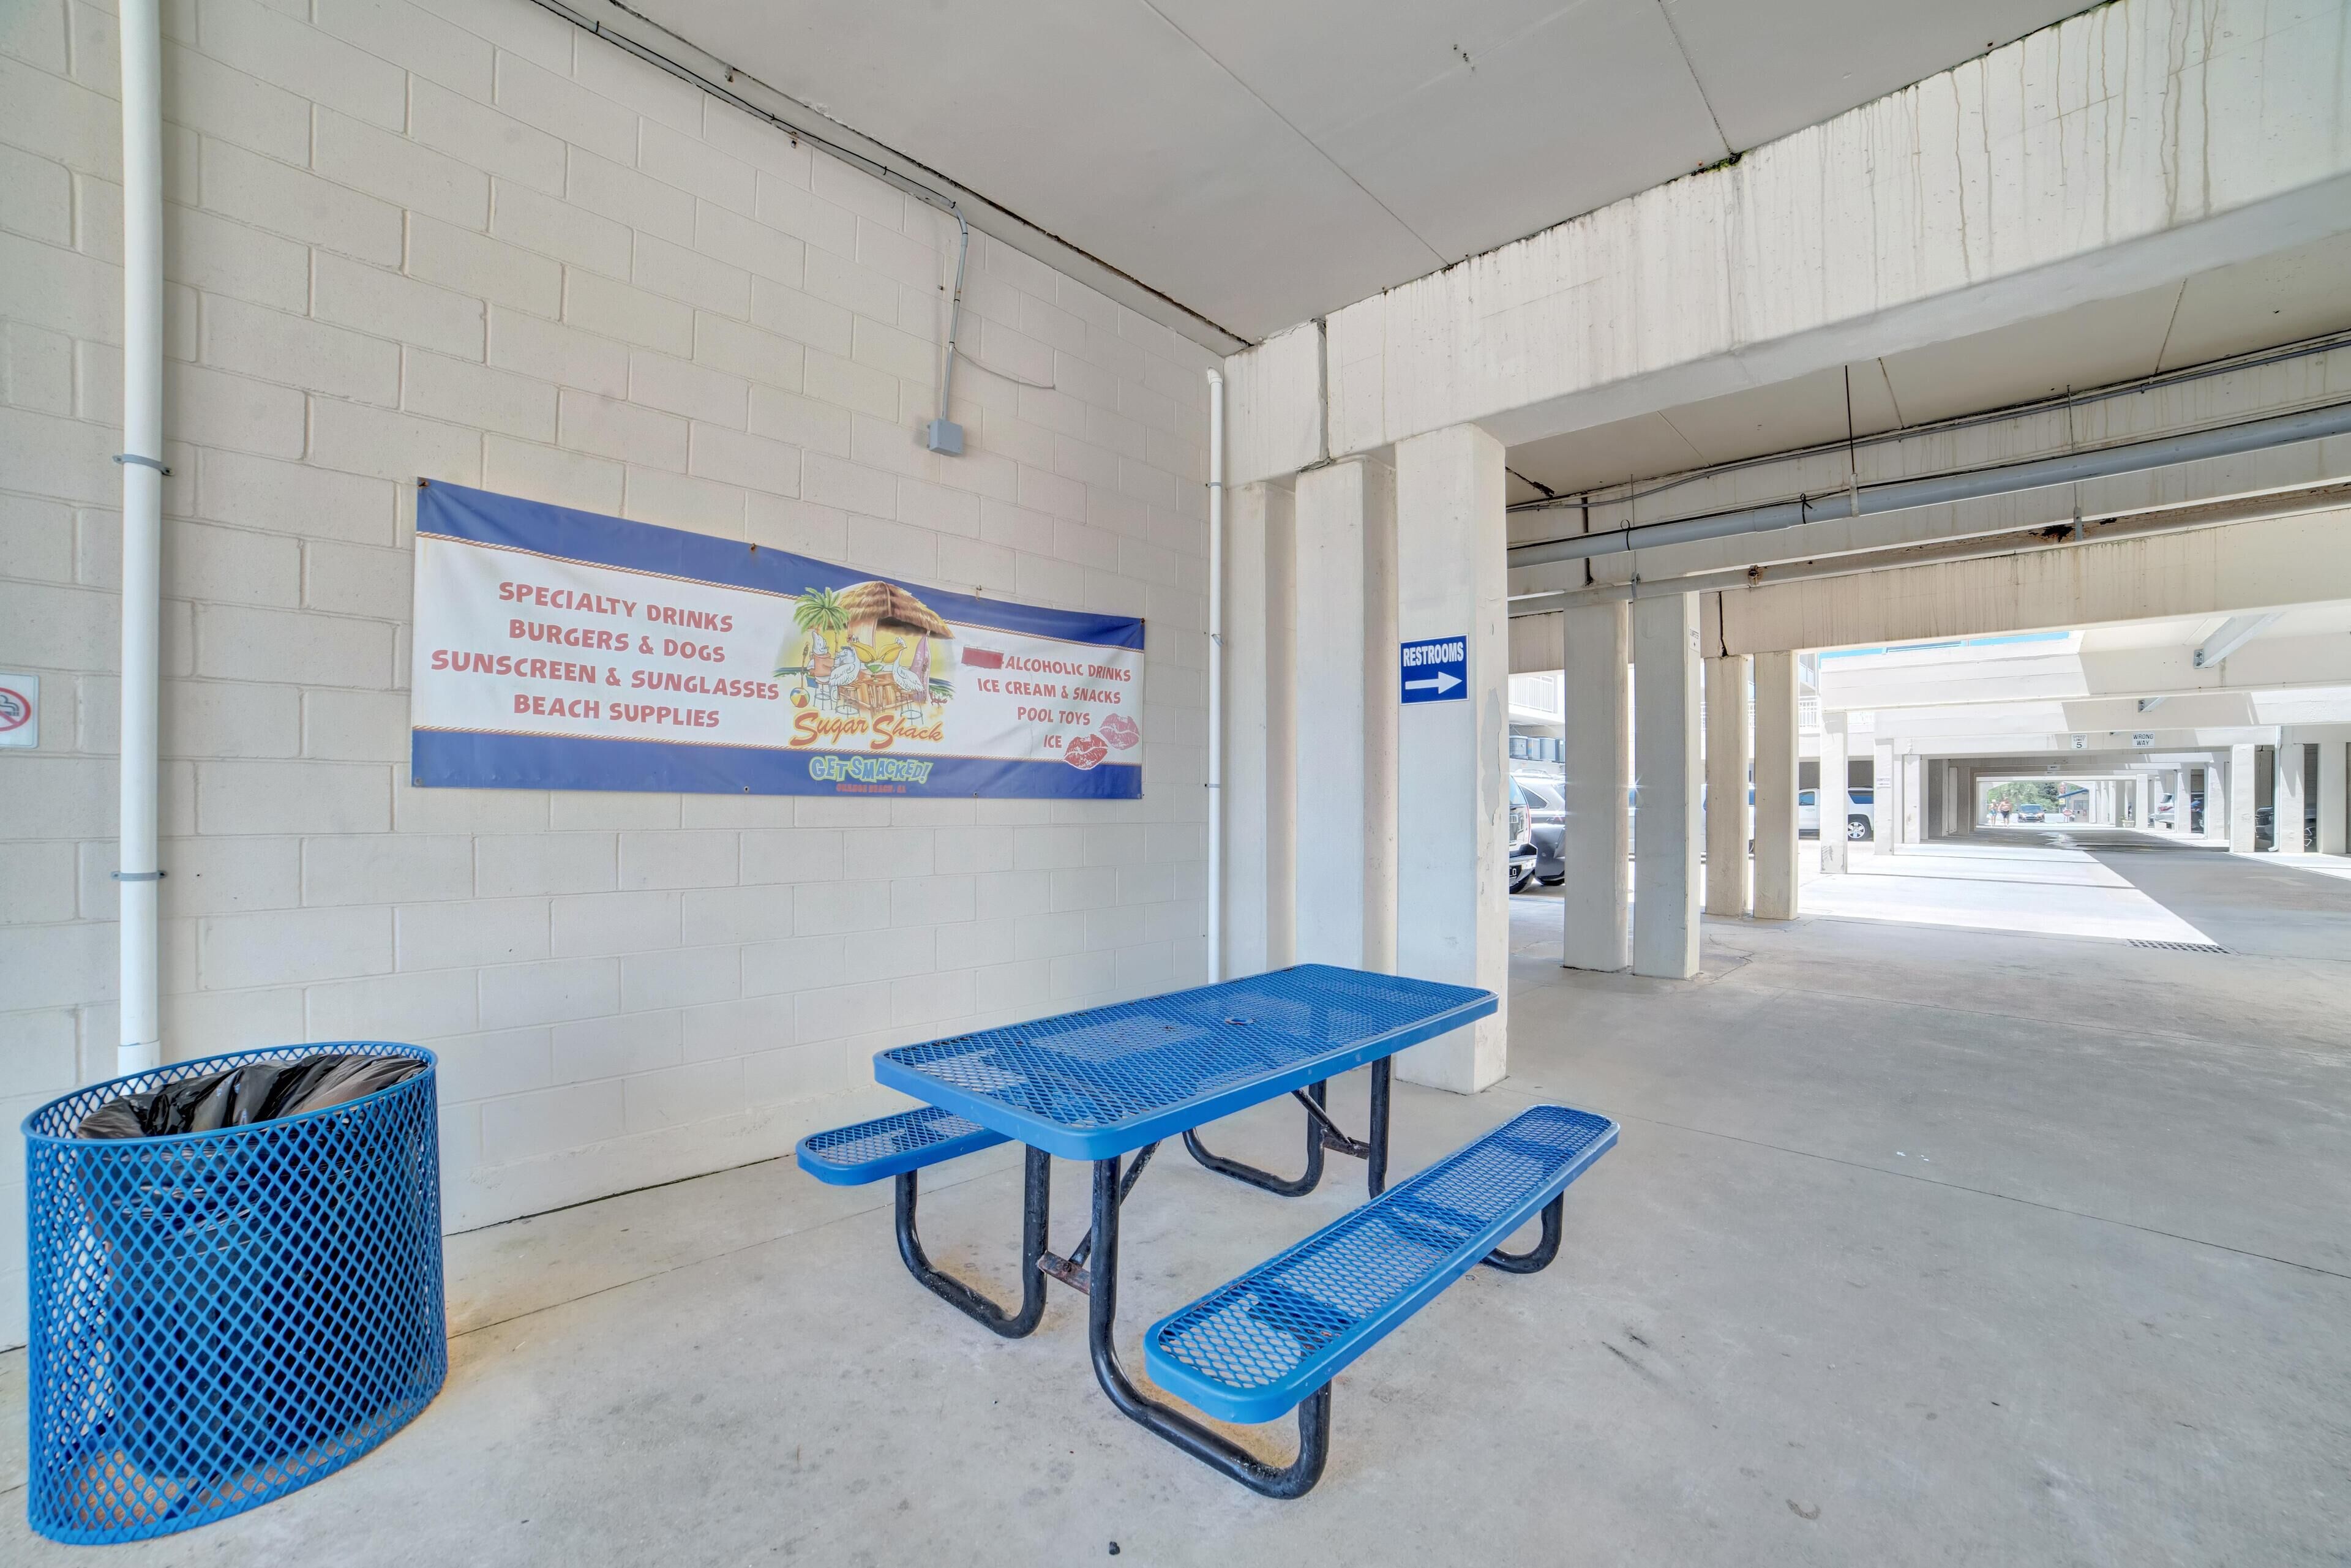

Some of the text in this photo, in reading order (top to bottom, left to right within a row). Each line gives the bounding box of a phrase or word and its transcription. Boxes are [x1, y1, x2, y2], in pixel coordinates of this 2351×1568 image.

[498, 582, 733, 632] SPECIALTY DRINKS
[509, 618, 726, 662] BURGERS & DOGS
[1403, 641, 1464, 667] RESTROOMS
[431, 650, 779, 700] SUNSCREEN & SUNGLASSES
[1087, 664, 1131, 682] DRINKS
[977, 678, 1122, 704] ICE CREAM & SNACKS
[514, 694, 720, 728] BEACH SUPPLIES
[1017, 707, 1091, 726] POOL TOYS
[790, 711, 943, 750] Sugar Shack
[1043, 734, 1062, 748] ICE
[810, 756, 934, 784] GET SMACKED!
